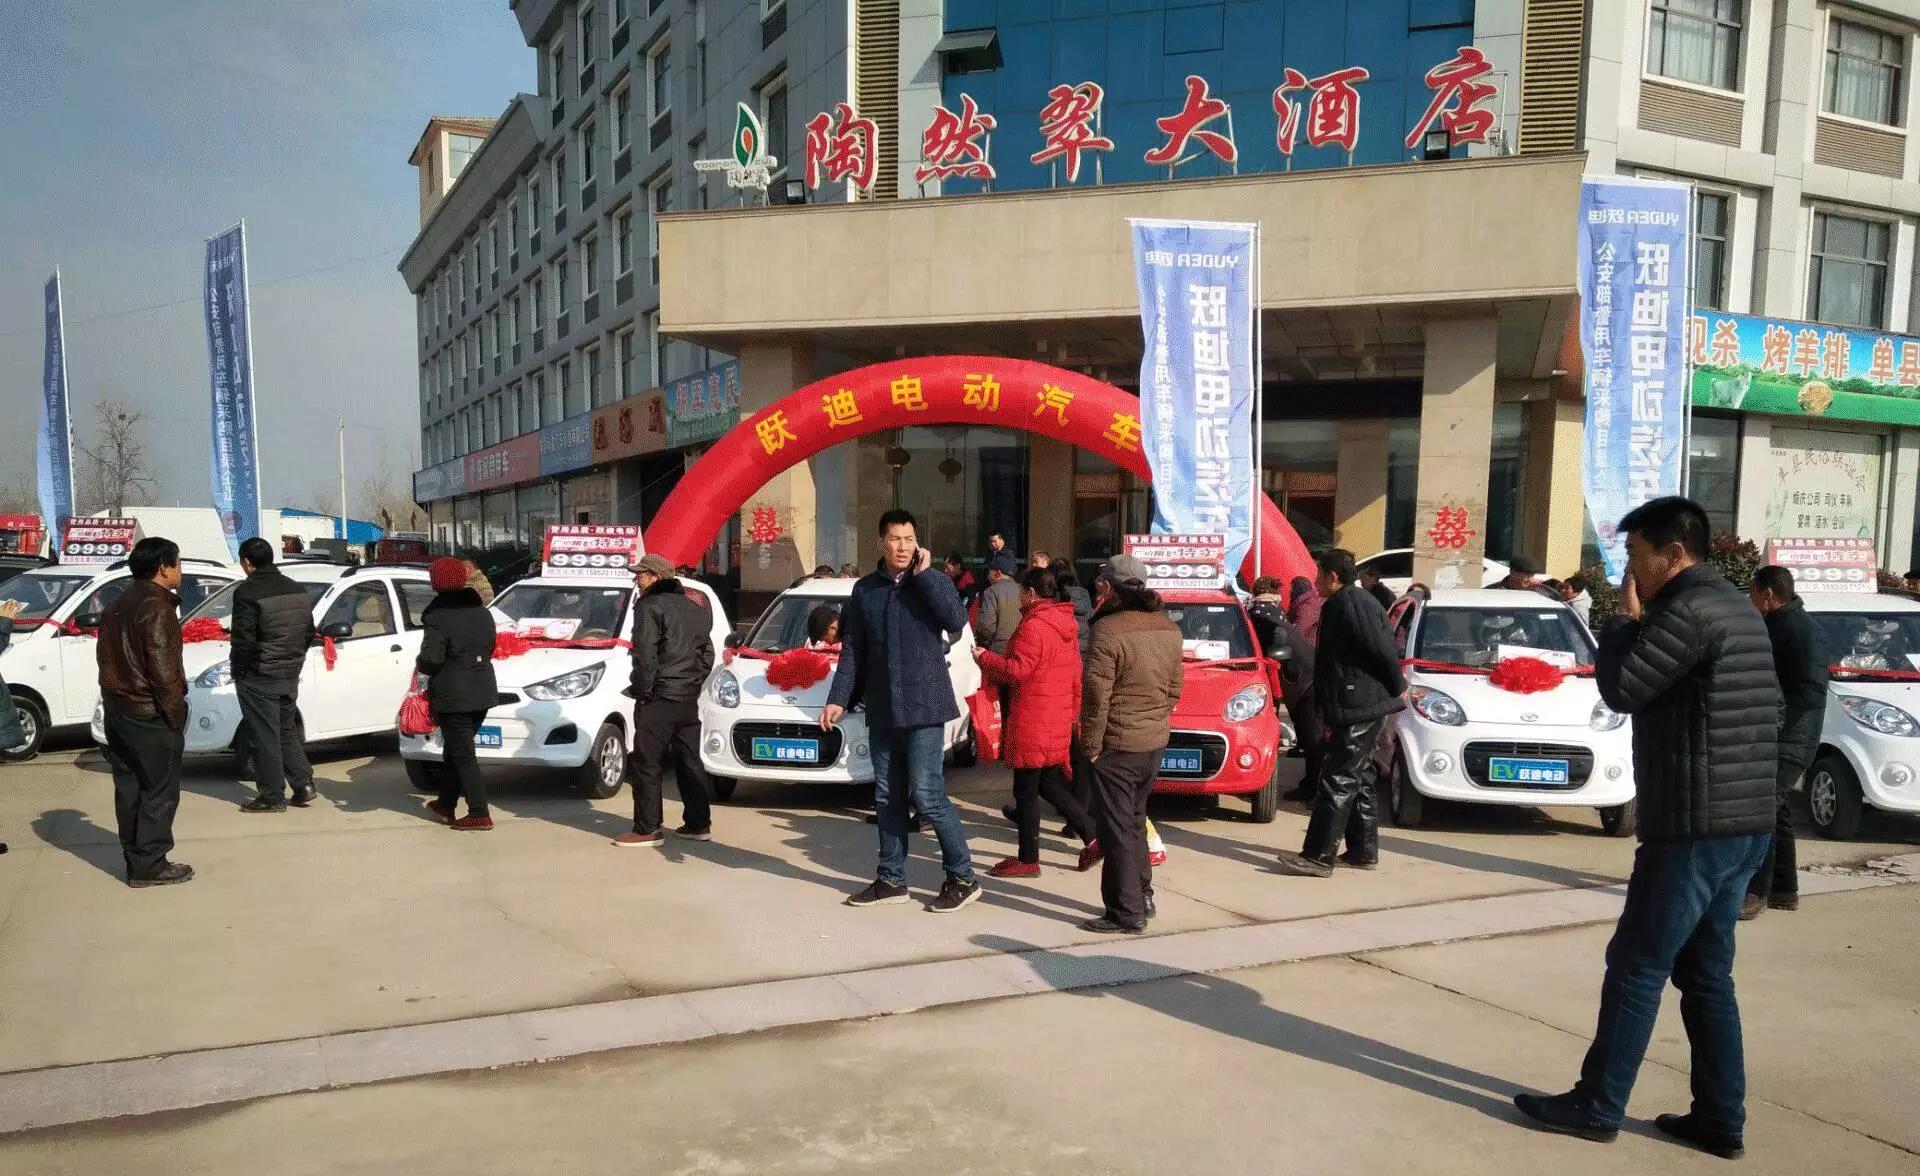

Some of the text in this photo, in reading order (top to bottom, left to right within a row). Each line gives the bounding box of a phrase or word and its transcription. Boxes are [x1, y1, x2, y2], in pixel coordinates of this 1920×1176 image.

[805, 46, 1498, 192] 陶然翠大酒店
[1761, 324, 1850, 380] 烤羊排
[1869, 338, 1920, 387] 单县
[755, 374, 1142, 456] 跃迪电动汽车
[68, 543, 124, 555] 9999
[551, 553, 626, 567] 9999
[755, 743, 776, 757] EV
[1493, 764, 1519, 779] EV
